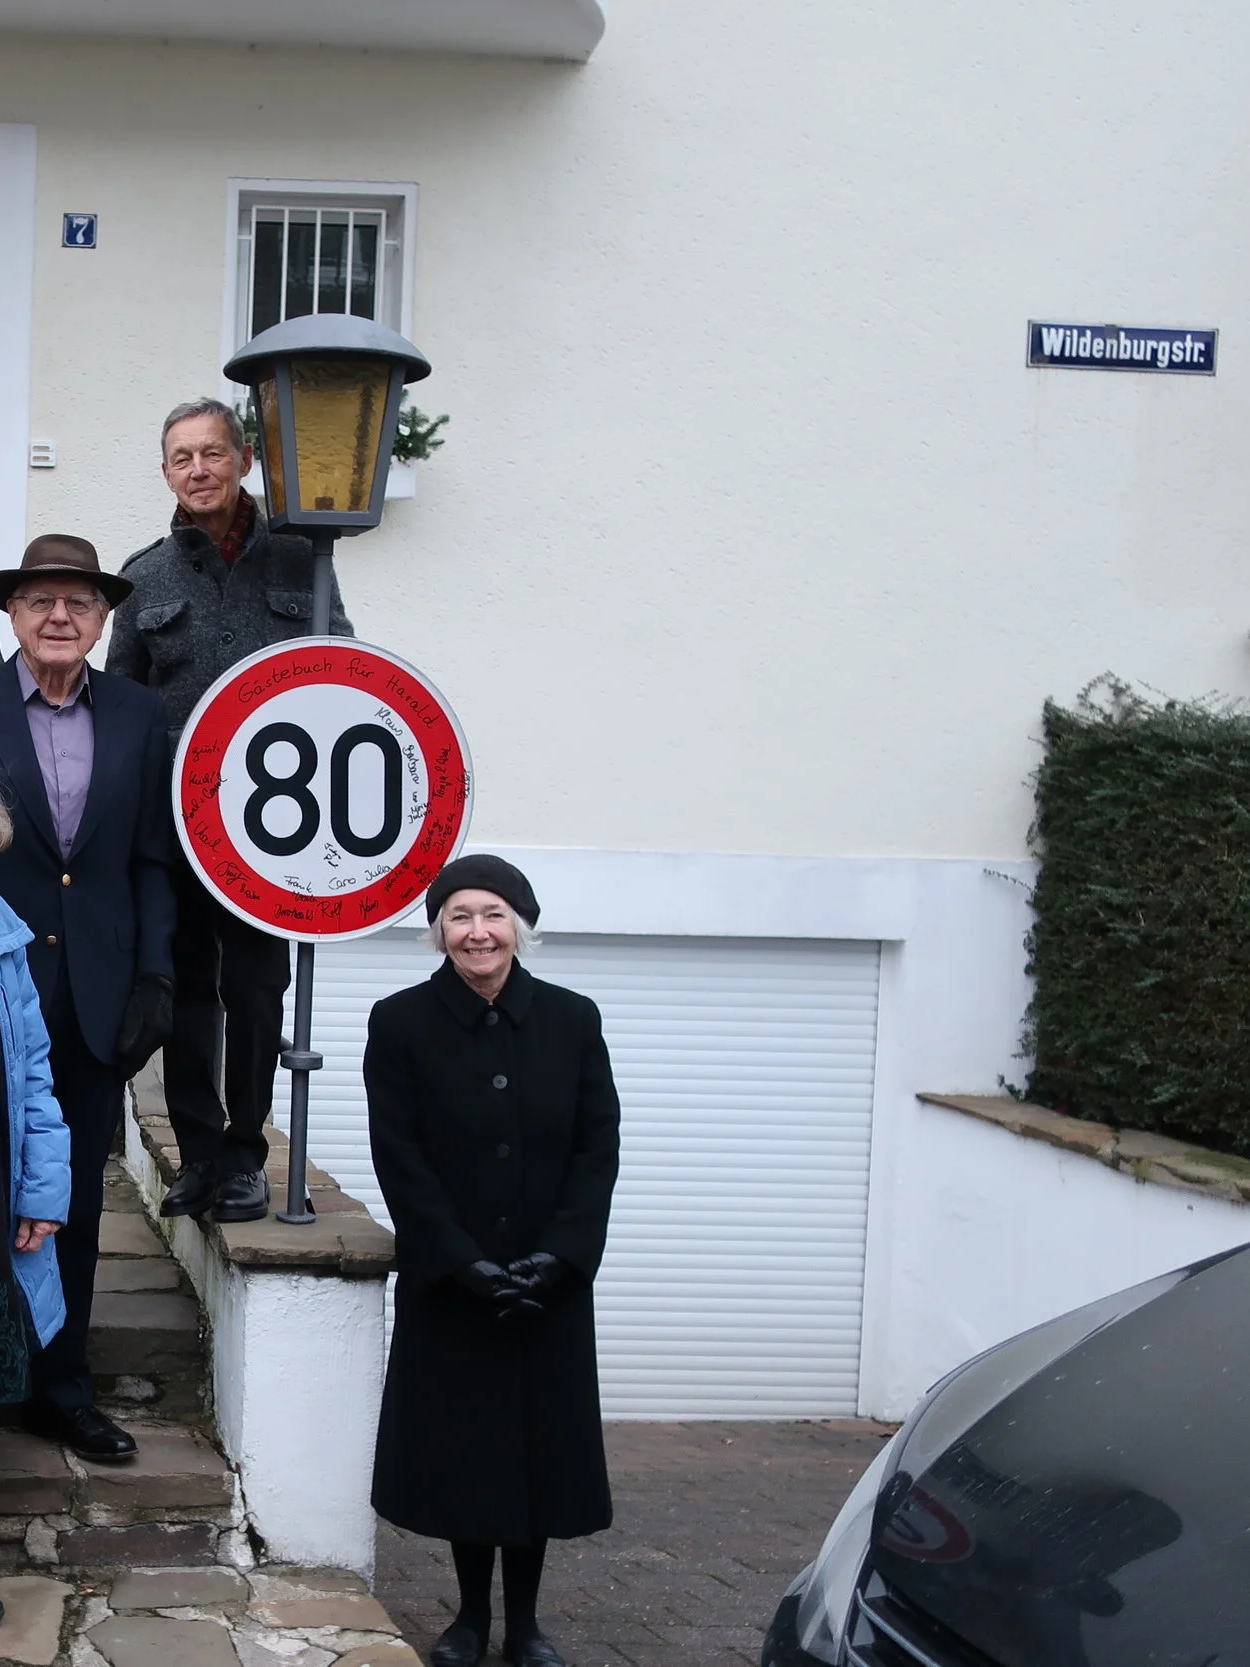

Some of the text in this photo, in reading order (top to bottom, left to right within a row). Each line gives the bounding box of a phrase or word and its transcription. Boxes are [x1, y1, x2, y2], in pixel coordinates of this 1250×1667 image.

[72, 217, 89, 244] 7
[1041, 327, 1206, 368] Wildenburgstr.
[238, 657, 439, 728] Gästebuch für Harald
[374, 707, 403, 736] Klaus
[402, 745, 421, 784] Barbara
[244, 722, 402, 857] 80
[284, 875, 312, 893] Frank
[328, 877, 357, 890] Caro
[364, 865, 393, 881] Julia
